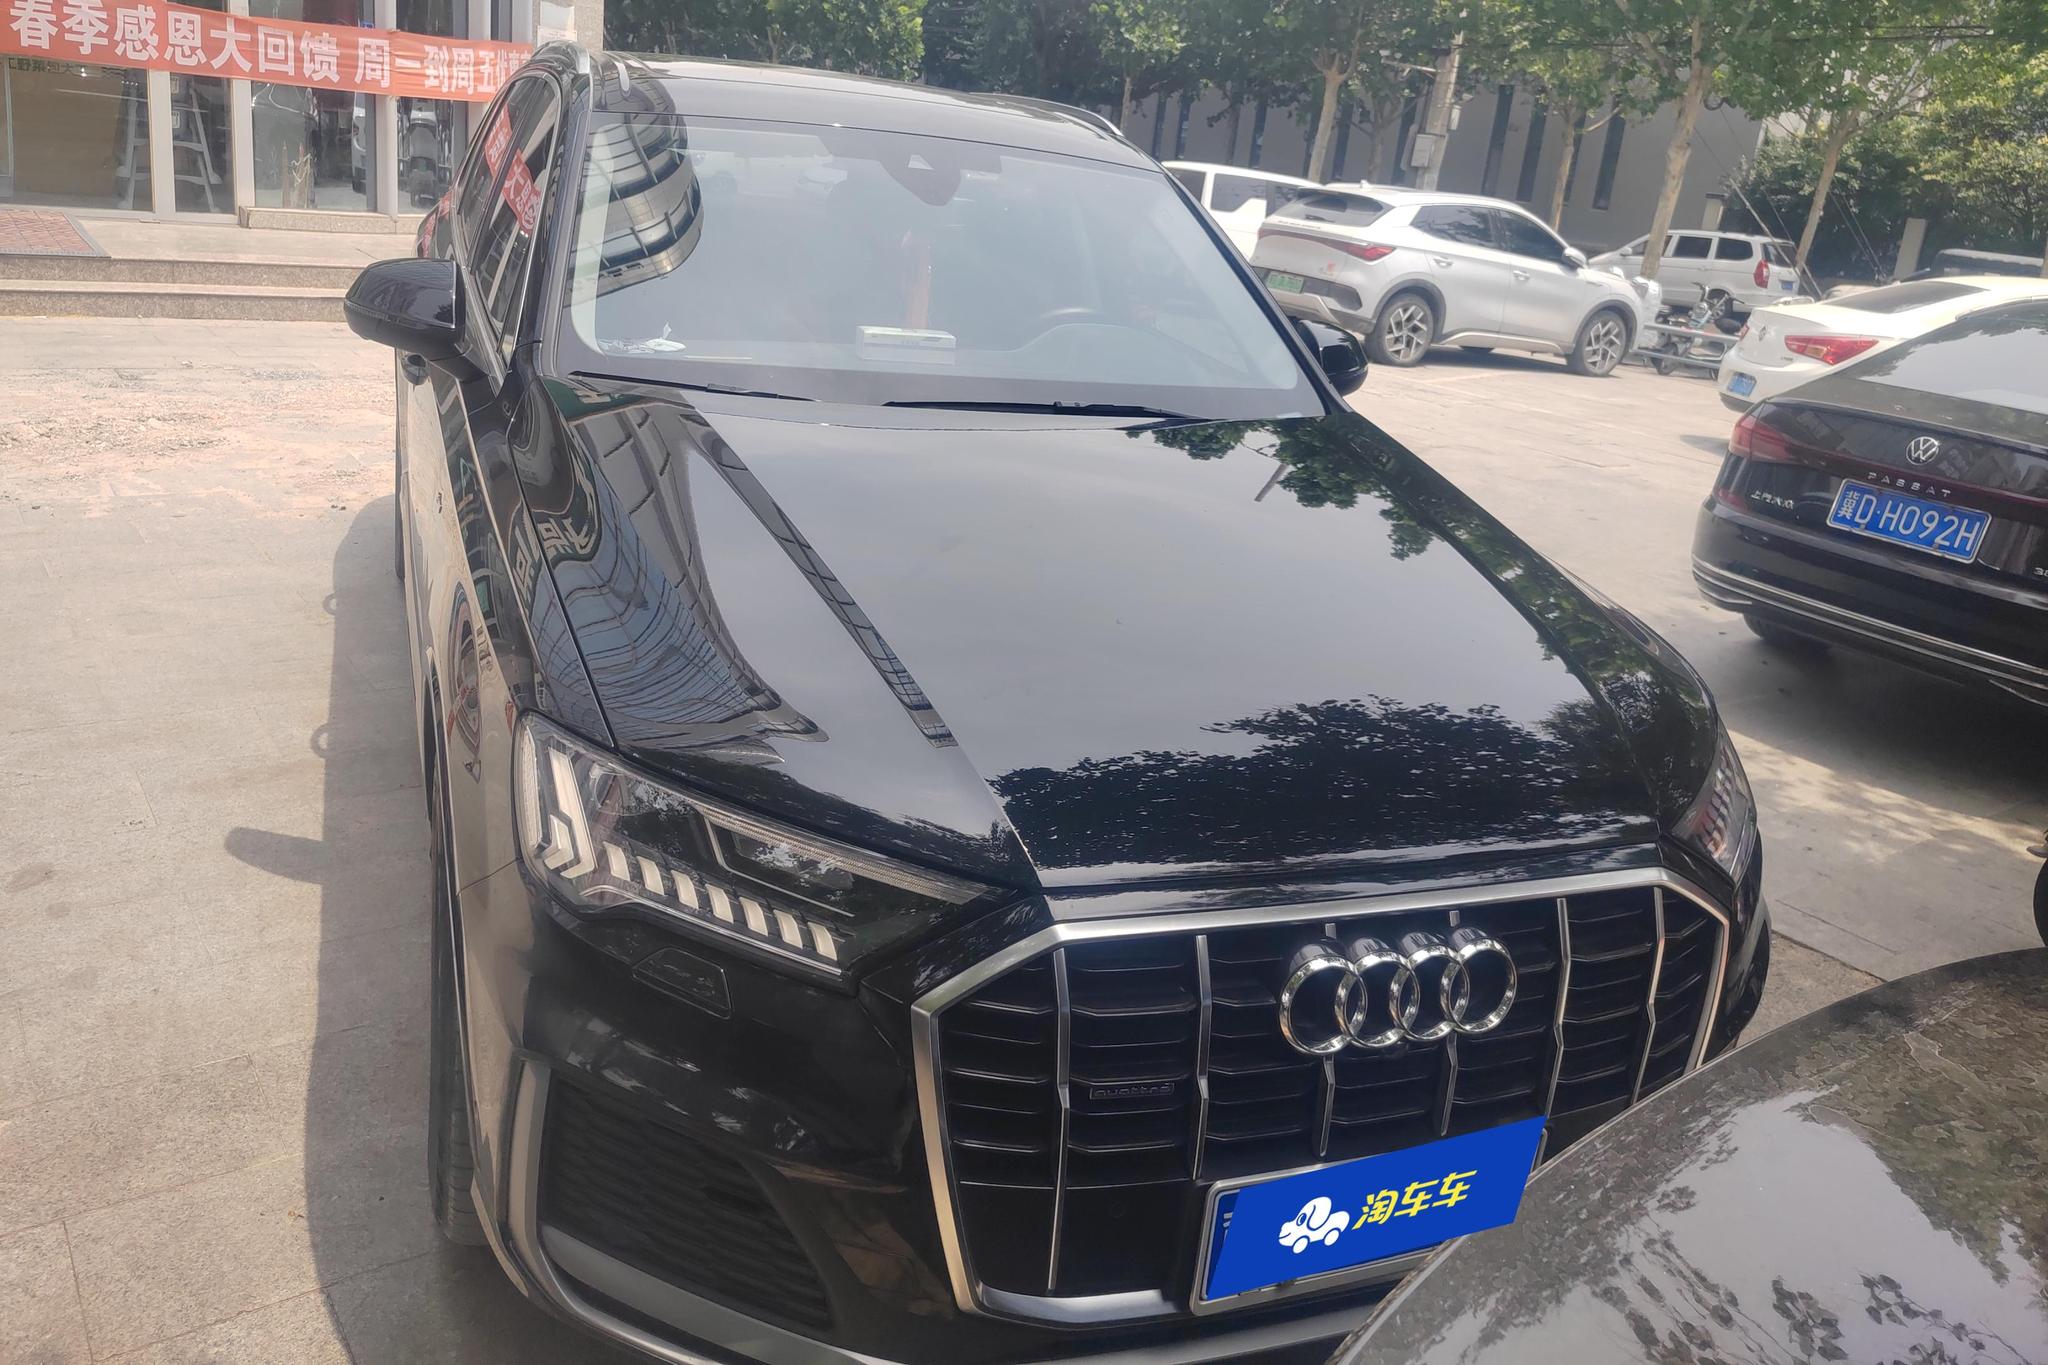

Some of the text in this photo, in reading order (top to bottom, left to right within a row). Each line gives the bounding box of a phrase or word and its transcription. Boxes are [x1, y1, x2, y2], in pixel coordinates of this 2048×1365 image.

[10, 0, 340, 85] 春季感恩大回馈
[1867, 471, 1952, 498] PASSAT
